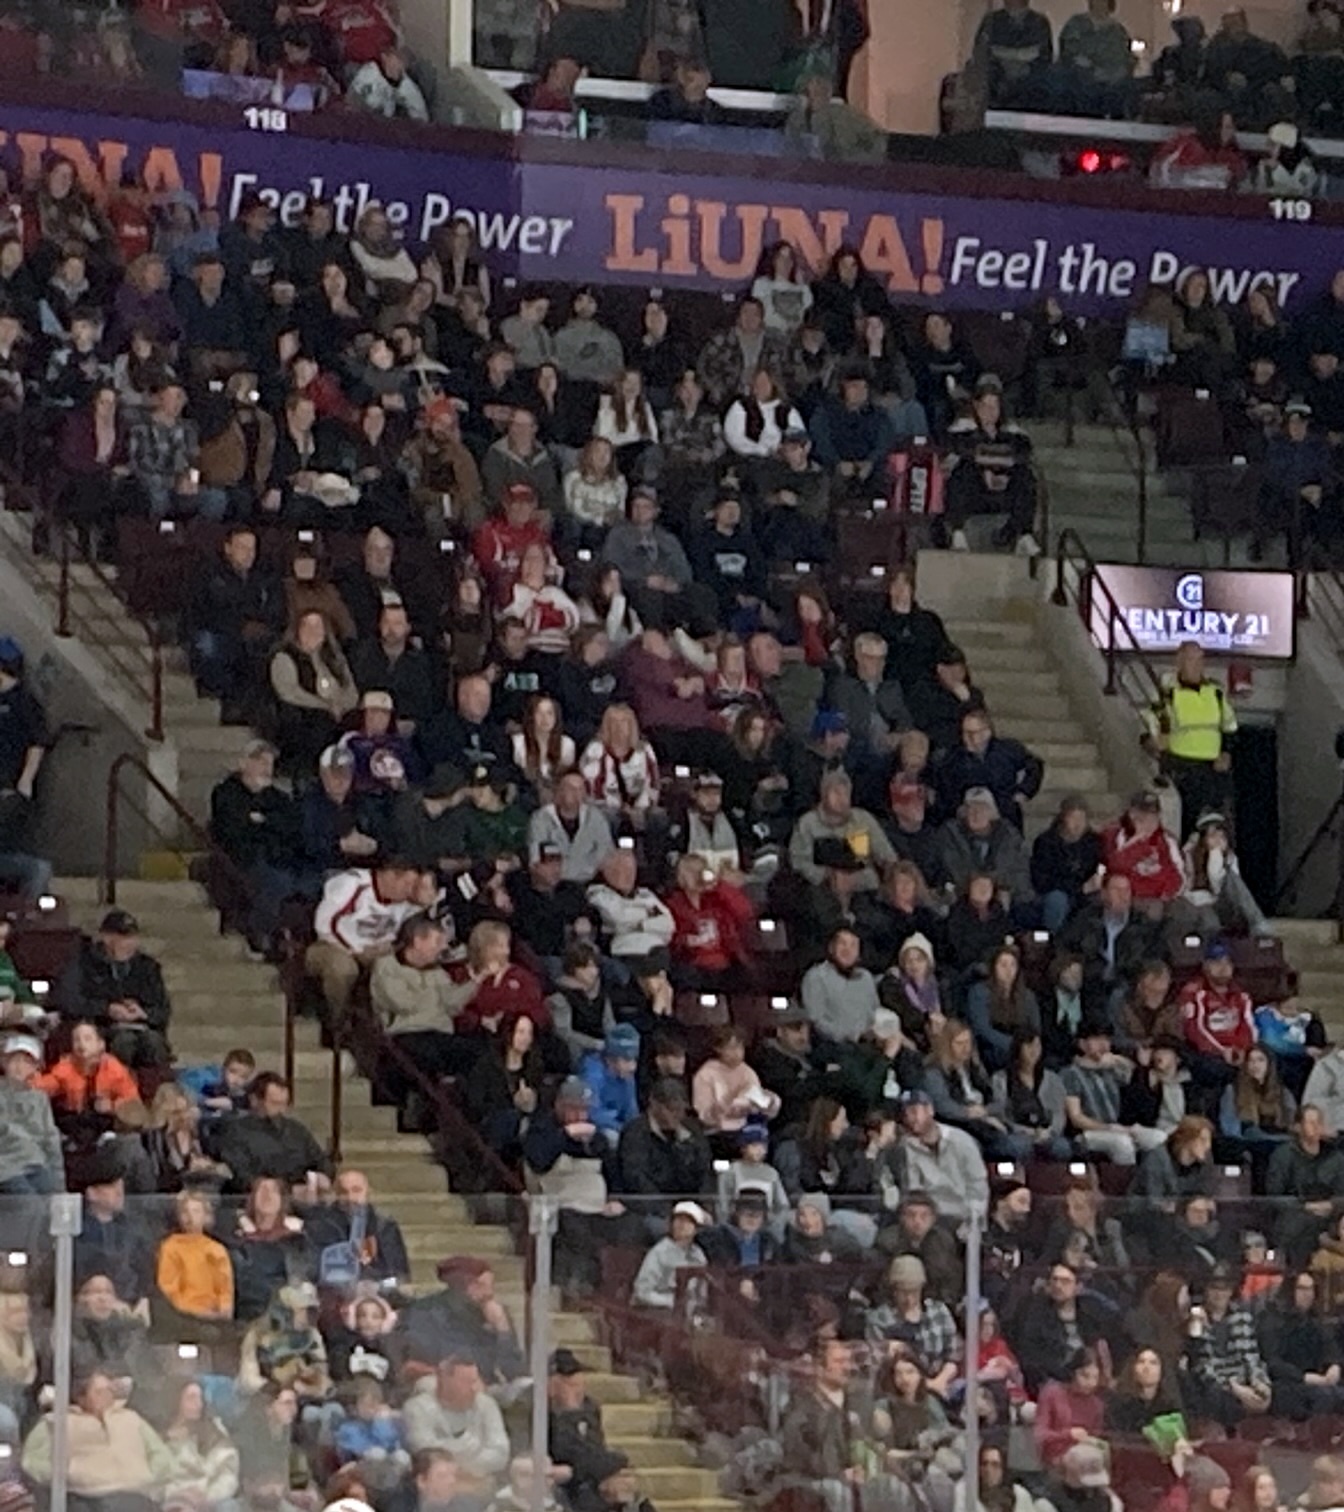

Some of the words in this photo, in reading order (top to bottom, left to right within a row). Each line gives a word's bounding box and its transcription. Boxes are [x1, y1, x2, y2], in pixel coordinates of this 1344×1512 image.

[243, 106, 288, 132] 118
[334, 183, 409, 240] the
[1269, 199, 1312, 221] 119
[604, 193, 945, 295] LiUNA!
[950, 237, 1048, 291] Feel
[1057, 243, 1137, 297] the
[1245, 614, 1270, 636] 21
